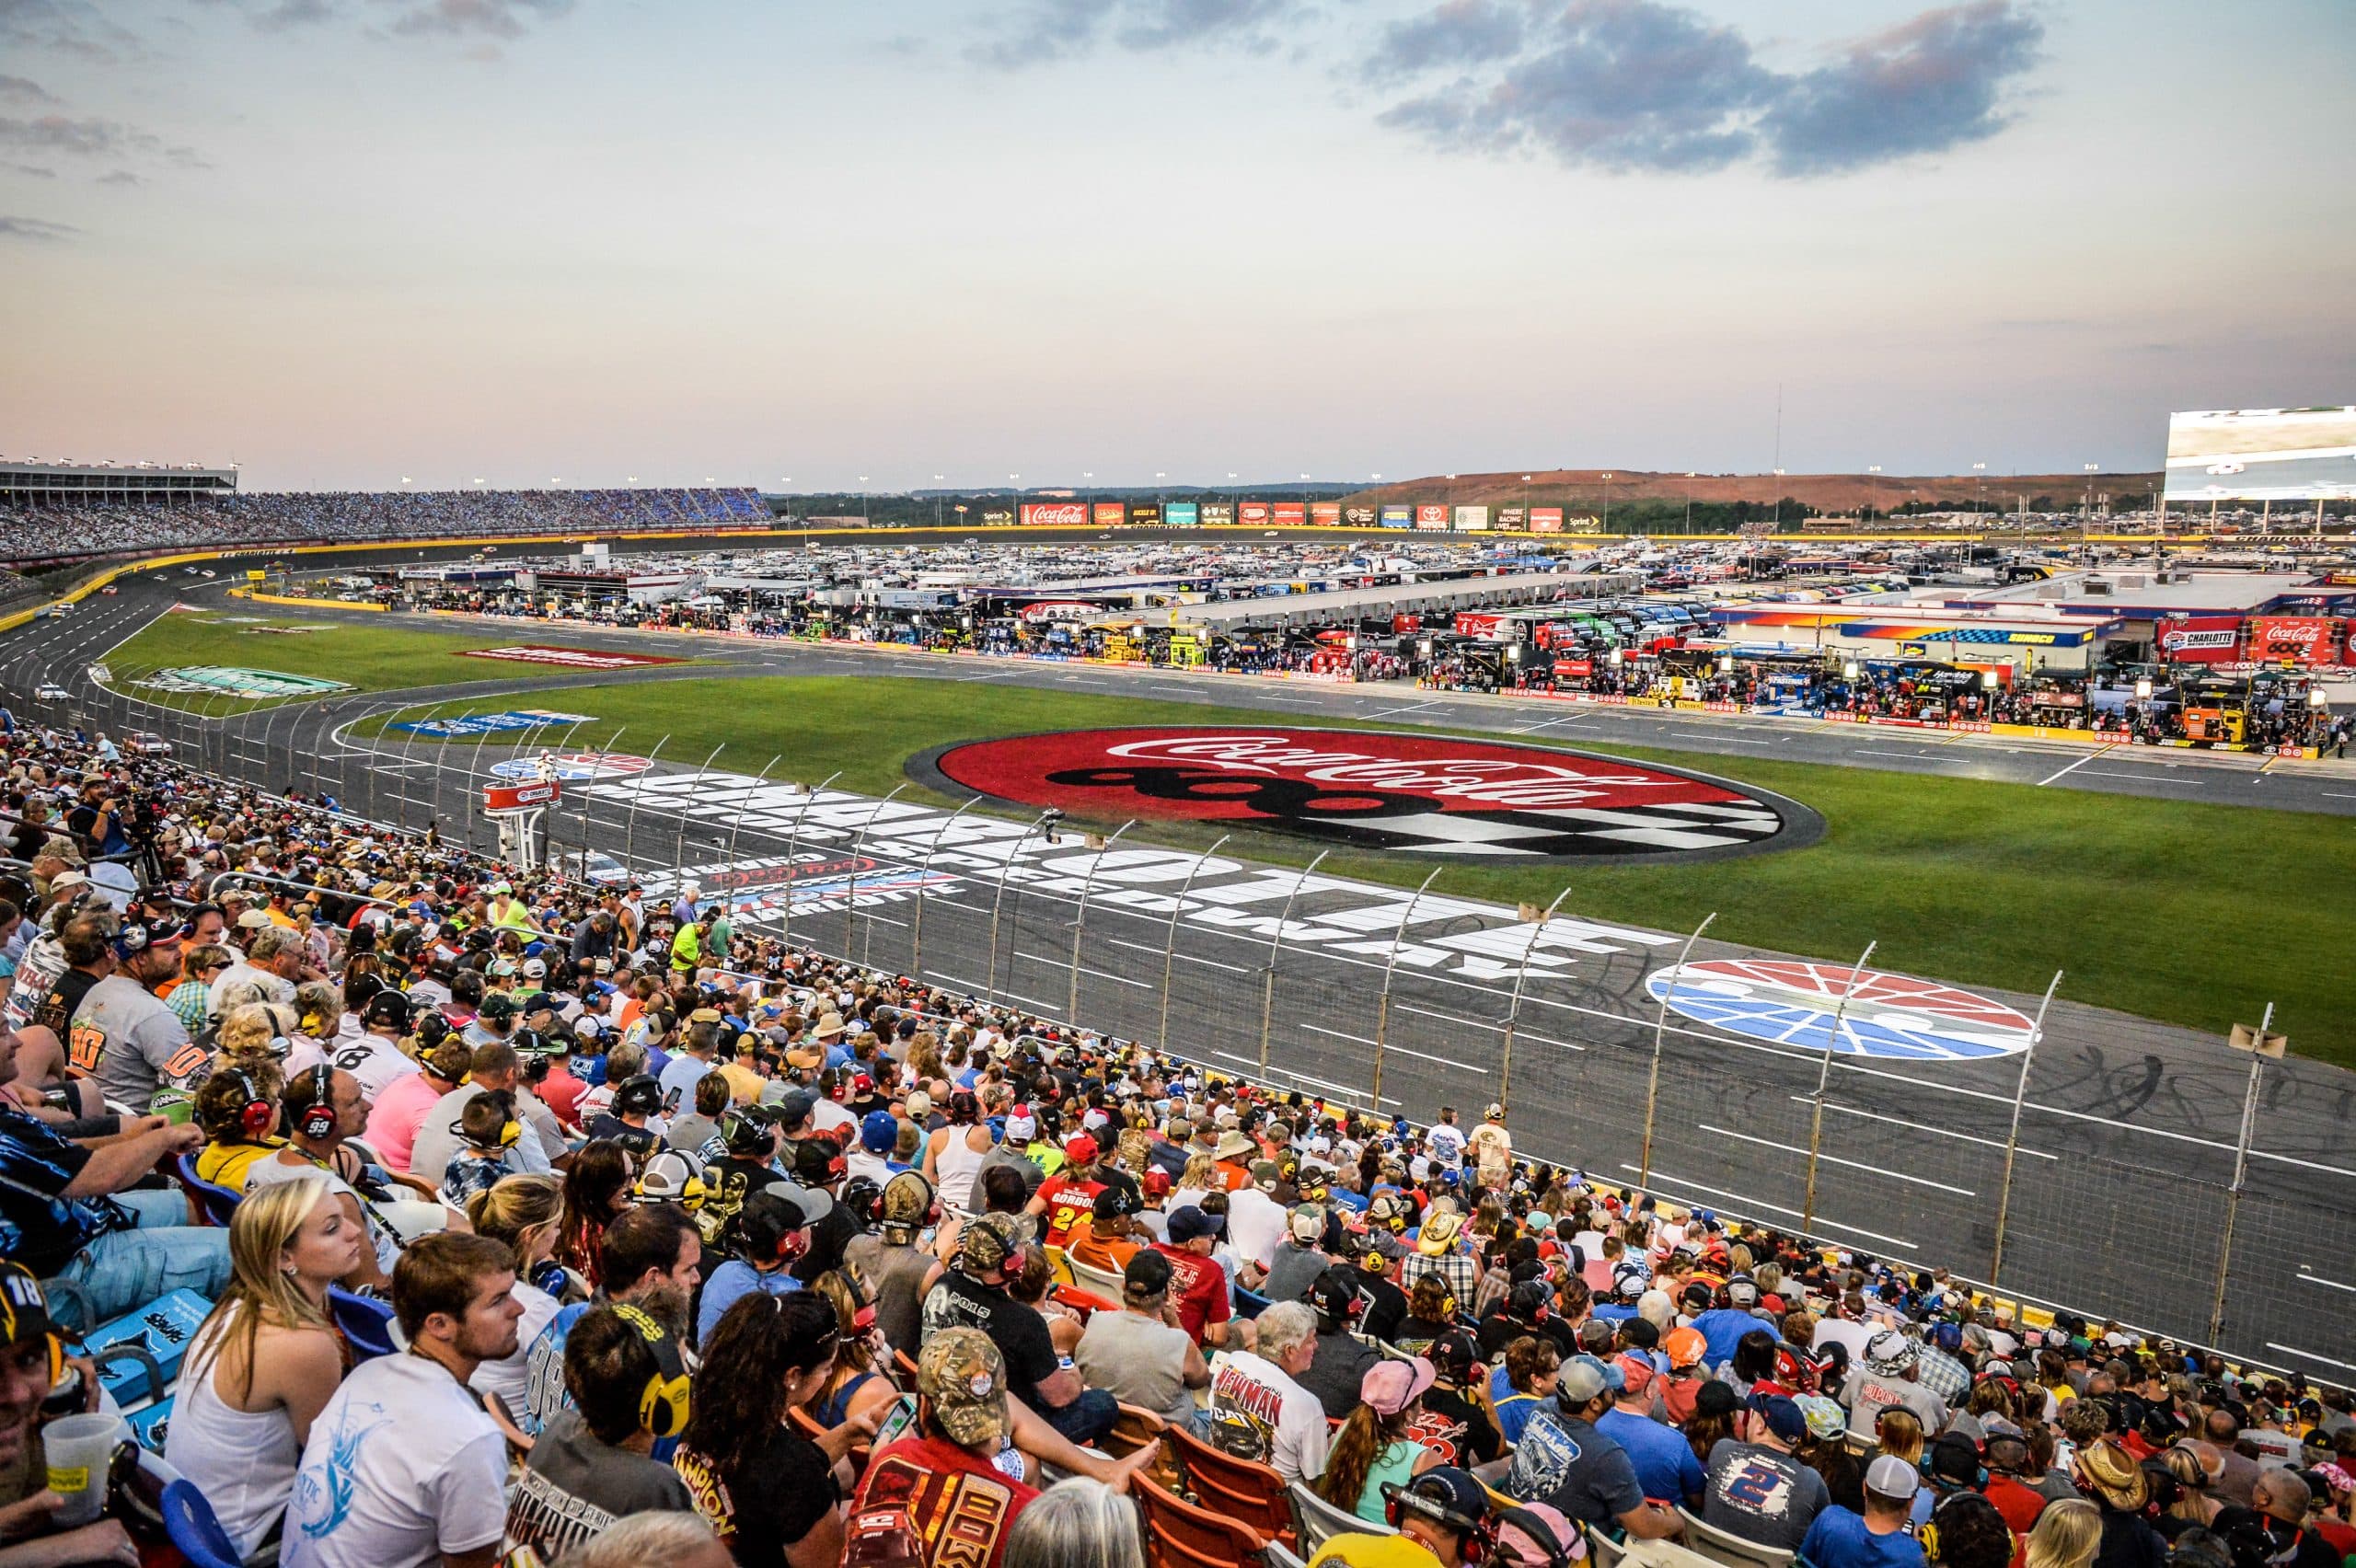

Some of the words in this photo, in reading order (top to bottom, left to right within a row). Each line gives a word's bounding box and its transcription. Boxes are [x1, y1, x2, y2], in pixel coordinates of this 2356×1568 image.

[984, 512, 1003, 520] Sprint
[1569, 517, 1590, 526] Sprint
[1417, 521, 1448, 529] TOYOTA
[2015, 572, 2034, 582] Sprint
[1461, 622, 1467, 634] 4
[2008, 633, 2055, 643] SUNOCO
[2188, 632, 2233, 642] CHARLOTTE
[2267, 641, 2304, 656] 600
[1934, 670, 1974, 680] Hendrick
[1661, 699, 1671, 708] 3
[2158, 739, 2195, 747] SUBWAY
[2211, 742, 2249, 751] SUBWAY
[1106, 737, 1690, 805] Coca-Cola
[620, 773, 1682, 965] CHARLOTTE
[568, 784, 856, 839] MOTOR
[851, 841, 1577, 979] SPEEDWAY
[71, 1026, 105, 1070] 10
[162, 1043, 208, 1078] 10
[307, 1121, 329, 1134] 99
[1053, 1207, 1094, 1232] 24
[6, 1275, 43, 1307] 18
[1314, 1291, 1327, 1302] CAT
[950, 1291, 991, 1319] 2015
[1440, 1343, 1451, 1354] 78
[1215, 1367, 1284, 1428] NEWMAN
[1214, 1407, 1251, 1428] CAT
[1726, 1462, 1782, 1508] 2
